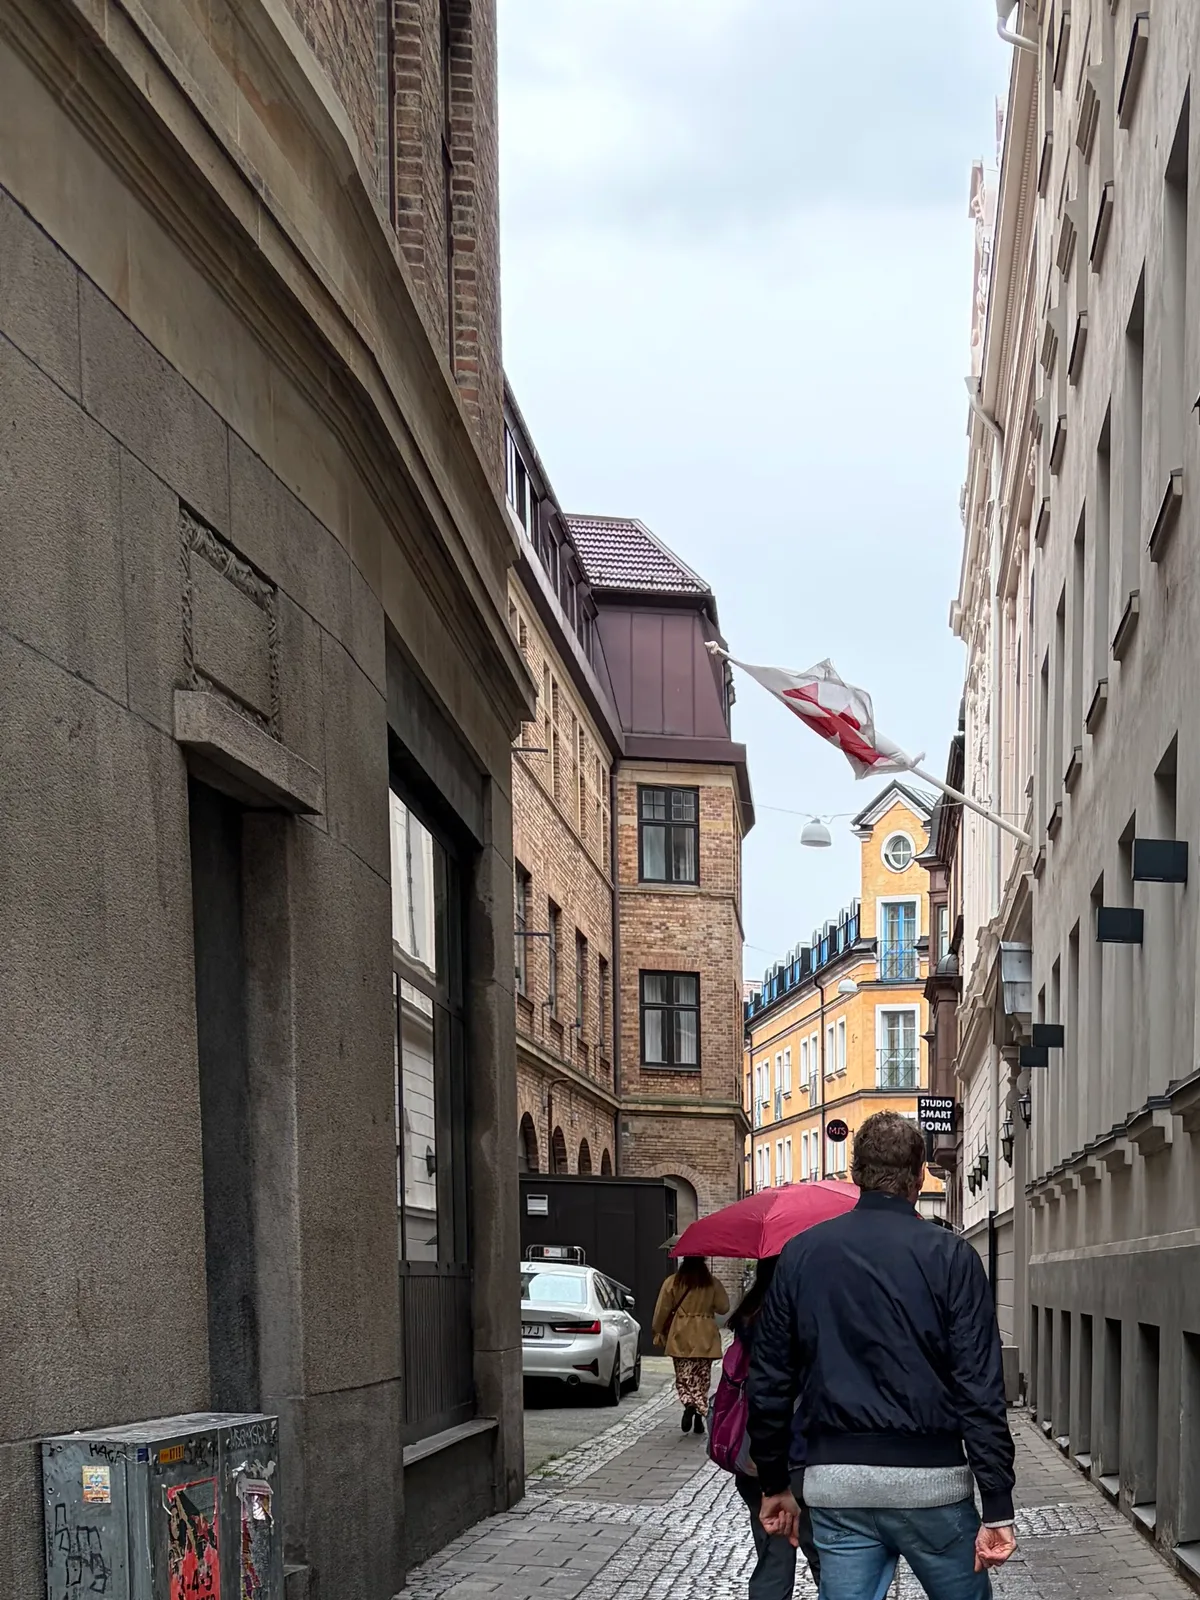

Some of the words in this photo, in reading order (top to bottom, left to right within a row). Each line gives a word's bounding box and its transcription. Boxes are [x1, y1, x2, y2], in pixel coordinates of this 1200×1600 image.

[921, 1099, 952, 1108] STUDIO
[920, 1110, 952, 1119] SMART
[920, 1121, 952, 1132] FORM
